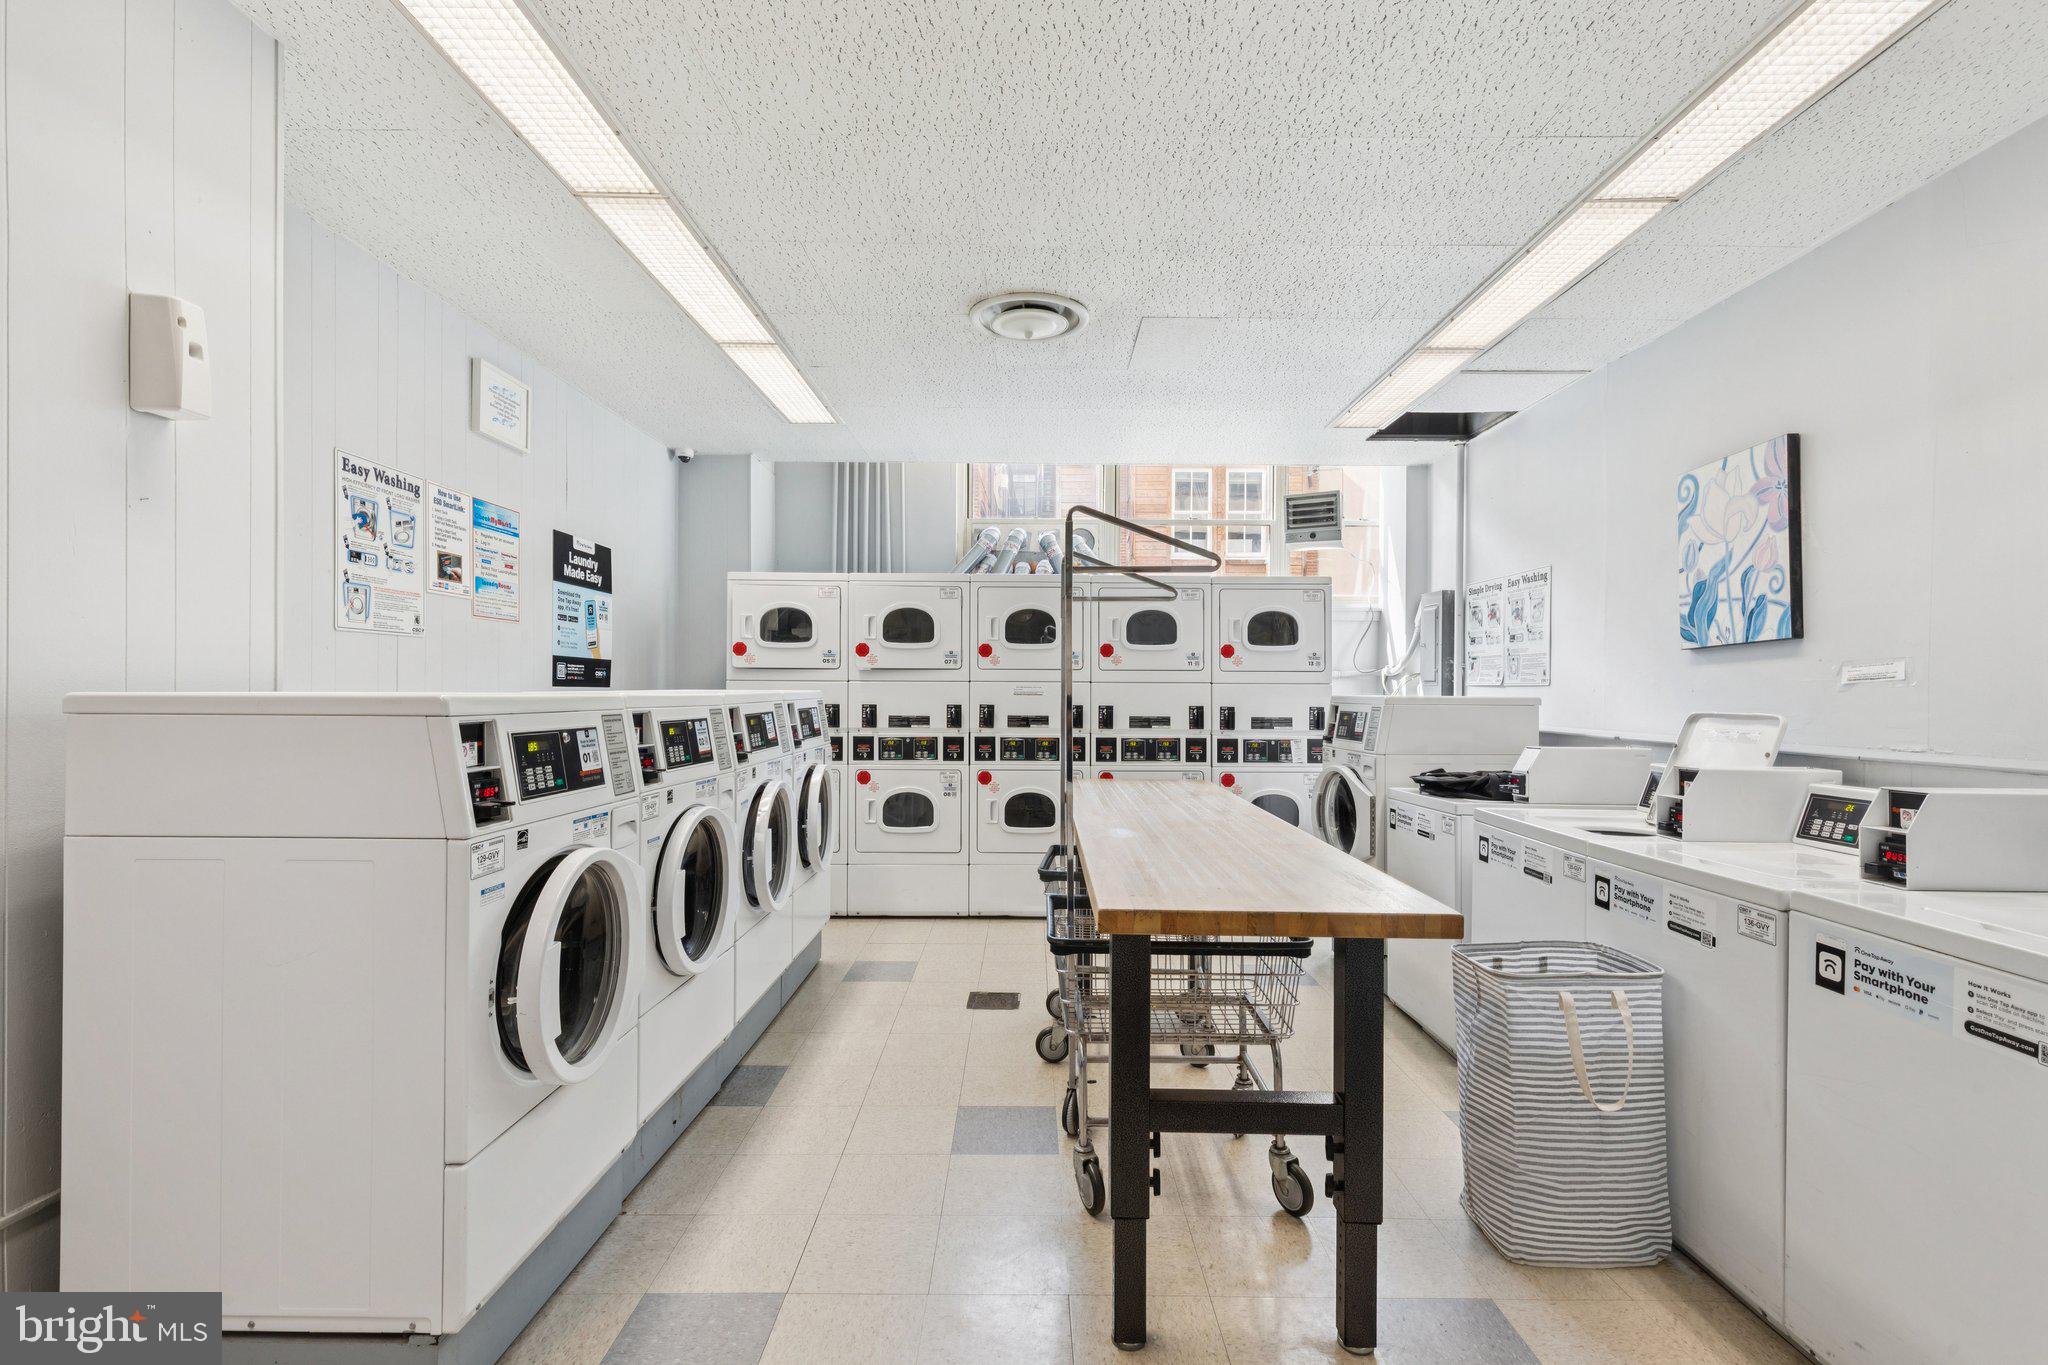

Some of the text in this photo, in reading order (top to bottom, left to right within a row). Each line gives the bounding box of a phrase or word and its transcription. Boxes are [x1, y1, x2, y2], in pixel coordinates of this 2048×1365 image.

[342, 457, 420, 498] Easy Washing
[437, 489, 447, 497] How
[453, 494, 461, 502] Use
[568, 551, 598, 572] Laundry
[563, 563, 602, 587] Made Easy
[1508, 572, 1548, 588] Easy Washing
[557, 588, 575, 597] Download
[1468, 583, 1502, 596] Simple Drying
[582, 753, 591, 763] 01
[477, 850, 500, 863] 129-GVY
[1491, 849, 1514, 862] Smartphone
[1507, 847, 1517, 855] Your
[1614, 884, 1655, 904] Pay with Your
[1614, 892, 1652, 913] Smartphone
[1861, 950, 1894, 966] OneTapAway
[1854, 959, 1935, 994] Pay with Your
[1854, 970, 1929, 1005] Smartphone
[1968, 980, 1982, 990] How
[1989, 987, 2011, 999] Works
[1987, 996, 1998, 1004] One
[1999, 1000, 2010, 1008] Tap
[2011, 1004, 2026, 1014] Away
[1976, 1008, 1993, 1018] Select
[2018, 1022, 2034, 1033] press
